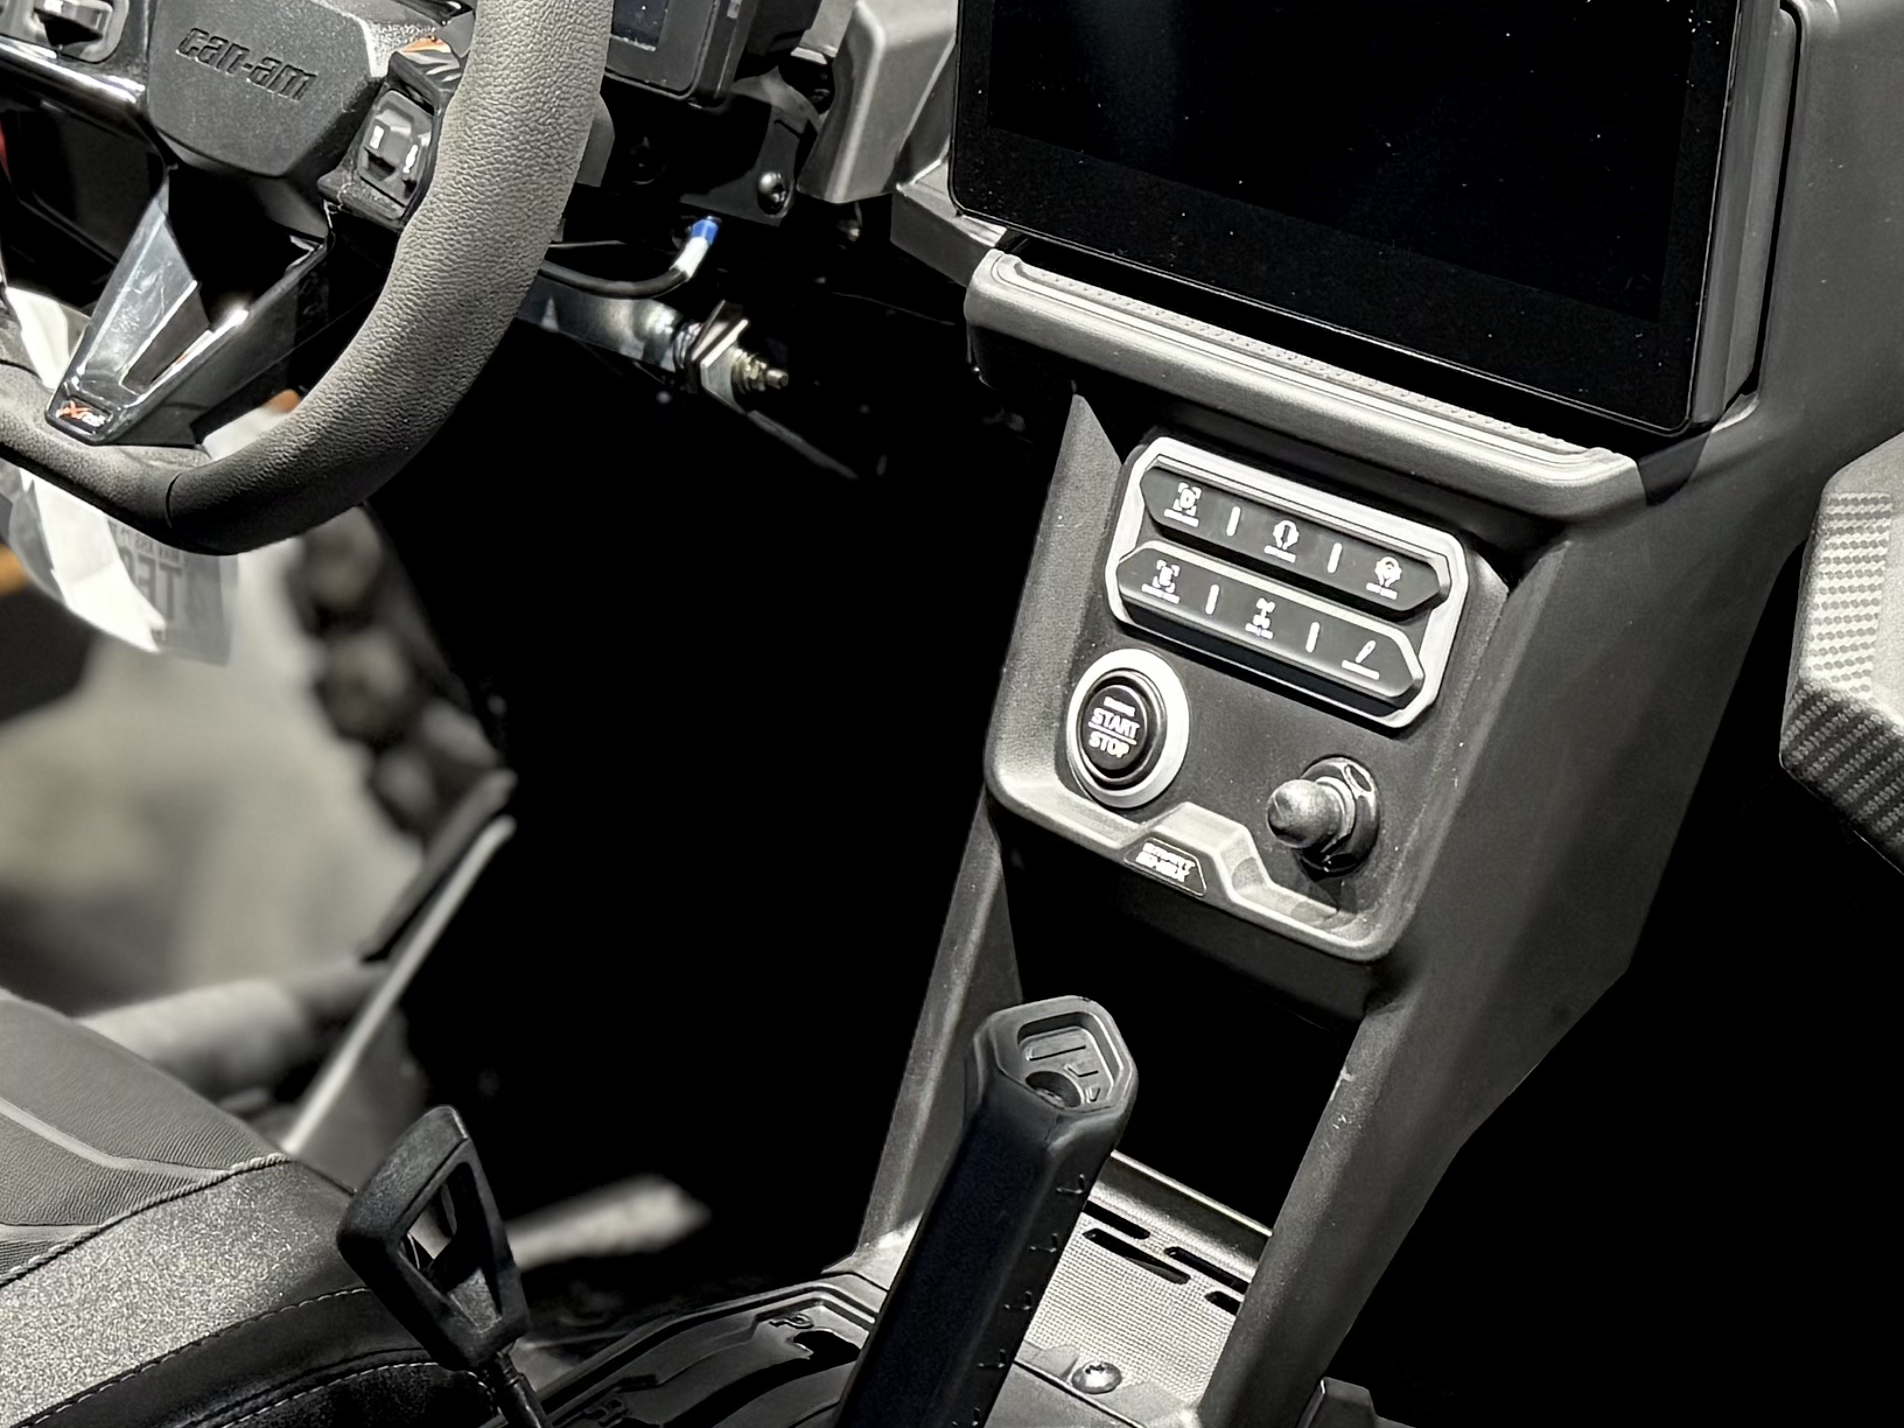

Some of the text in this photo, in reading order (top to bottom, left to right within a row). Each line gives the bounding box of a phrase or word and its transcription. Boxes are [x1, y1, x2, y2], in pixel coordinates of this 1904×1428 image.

[174, 25, 318, 101] can-am
[1091, 707, 1140, 739] START
[1088, 731, 1131, 758] STOP
